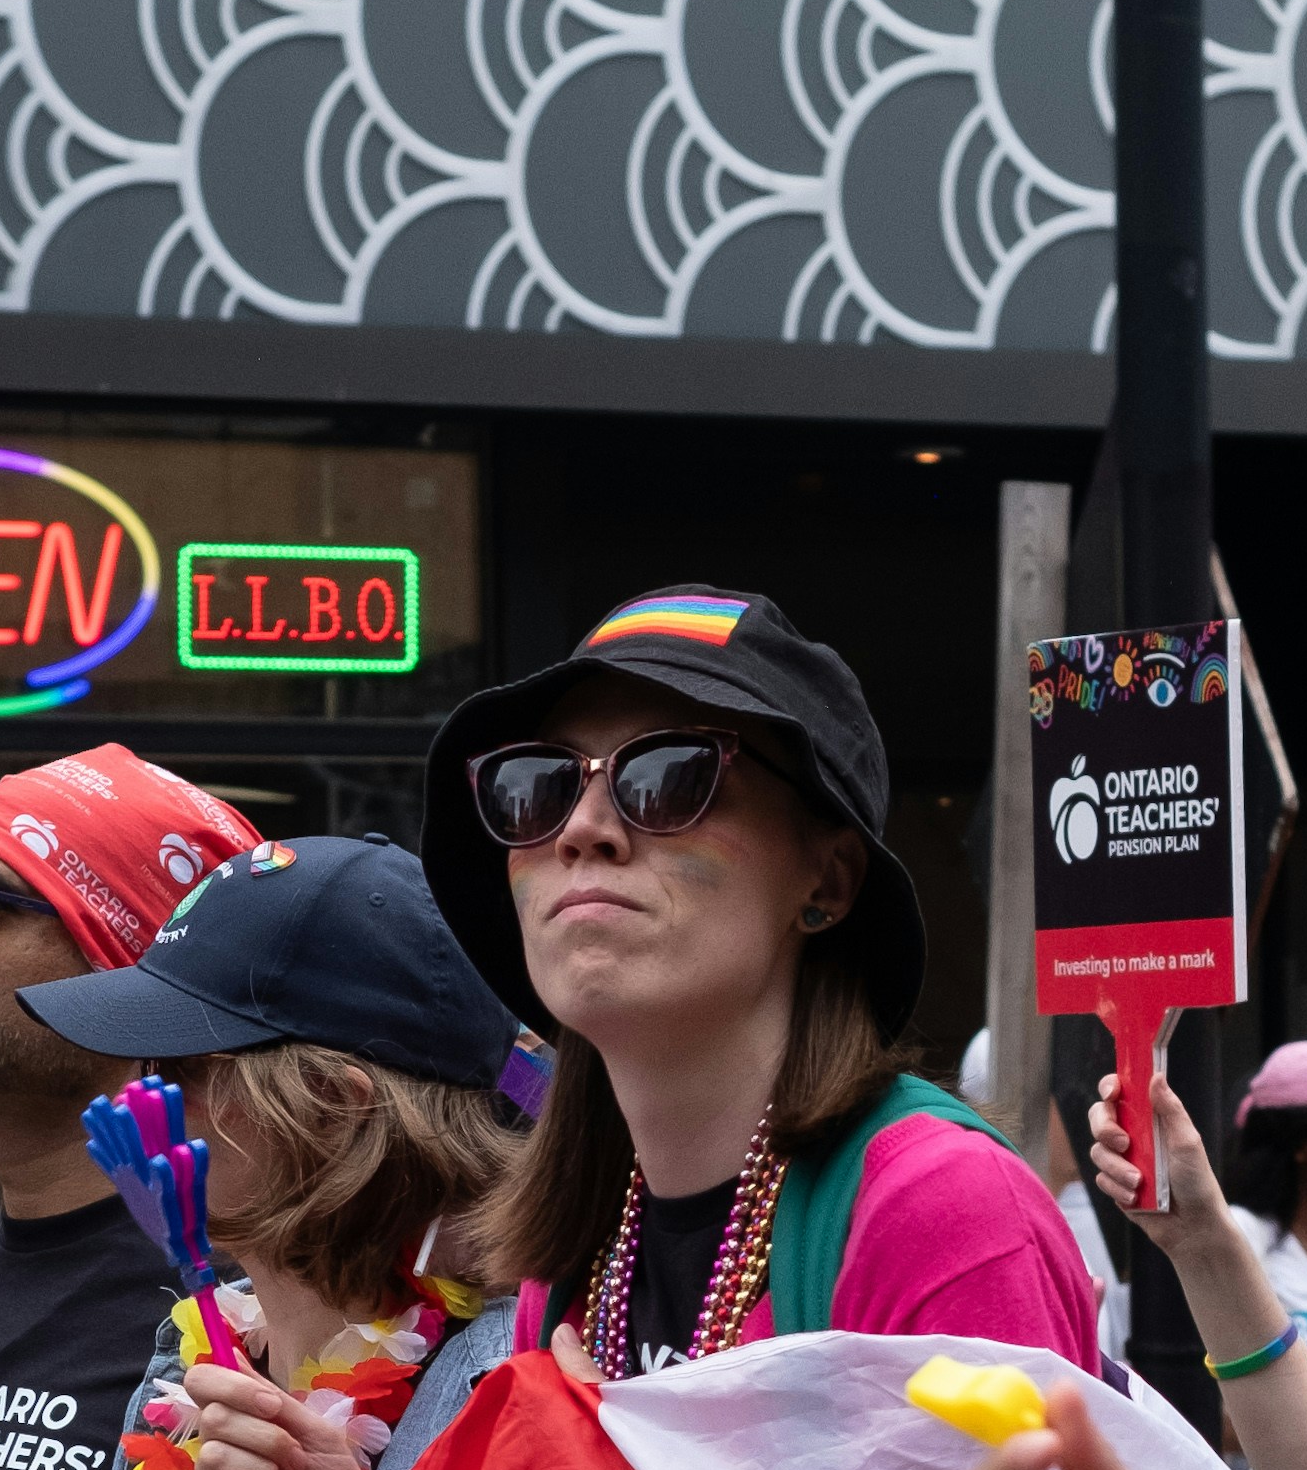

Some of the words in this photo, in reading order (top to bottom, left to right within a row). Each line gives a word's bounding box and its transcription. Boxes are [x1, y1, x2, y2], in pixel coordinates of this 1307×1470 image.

[1104, 764, 1199, 800] ONTARIO
[1104, 797, 1220, 835] TEACHERS'
[1108, 836, 1162, 858] PENSION
[1164, 833, 1200, 853] PLAN
[63, 848, 141, 931] ONTARIO
[1054, 955, 1111, 978] Investing
[1112, 956, 1126, 973] to
[1128, 951, 1166, 972] make
[1168, 955, 1177, 969] a
[1179, 948, 1216, 969] mark
